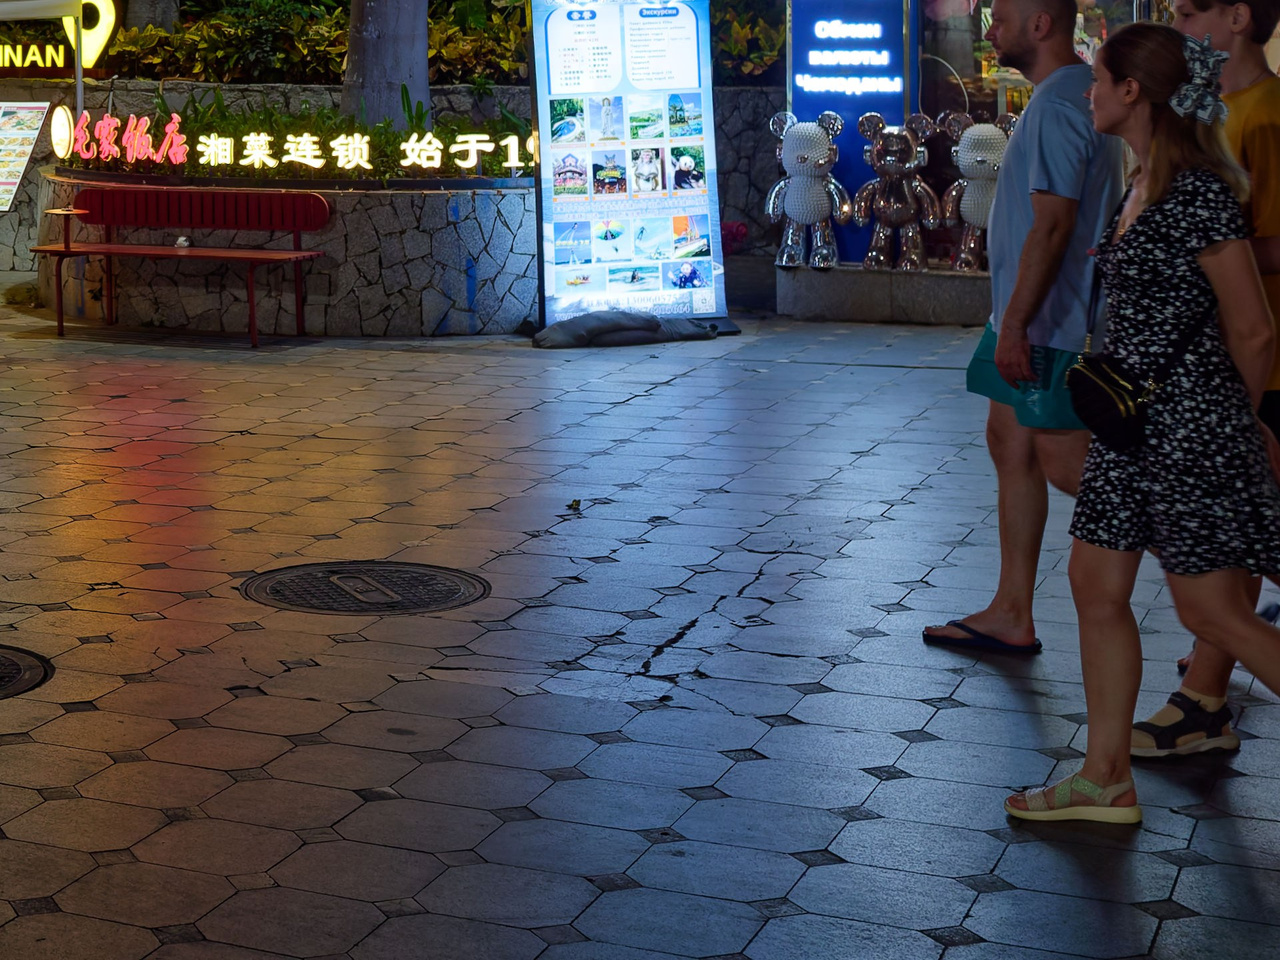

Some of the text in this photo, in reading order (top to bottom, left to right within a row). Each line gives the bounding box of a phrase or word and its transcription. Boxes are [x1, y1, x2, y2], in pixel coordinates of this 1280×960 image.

[73, 112, 188, 164] 毛家饭店
[195, 131, 375, 171] 湘菜连锁
